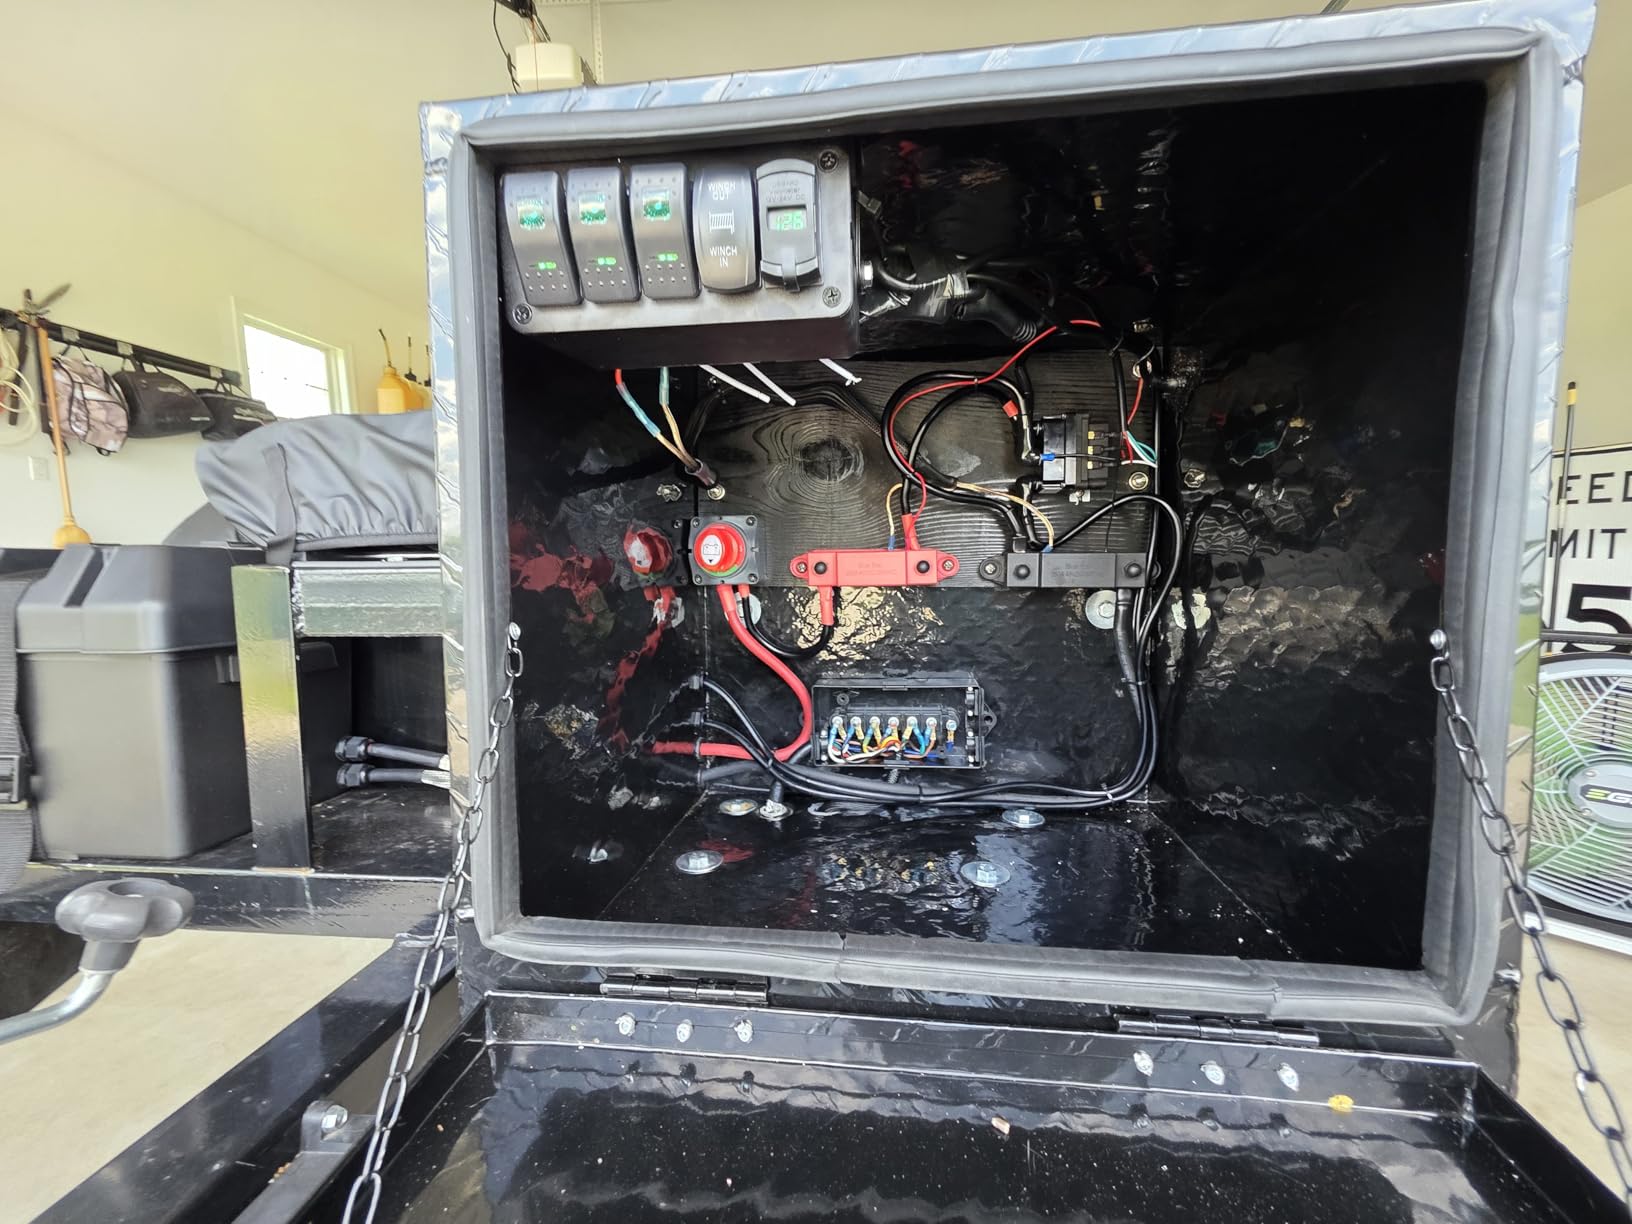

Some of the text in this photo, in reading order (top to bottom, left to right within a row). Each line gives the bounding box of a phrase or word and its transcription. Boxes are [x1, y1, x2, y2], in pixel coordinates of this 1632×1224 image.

[708, 182, 736, 192] WINCH
[712, 191, 729, 201] OUT
[709, 245, 738, 257] WINCH
[719, 256, 729, 268] IN
[1585, 788, 1632, 805] EG
